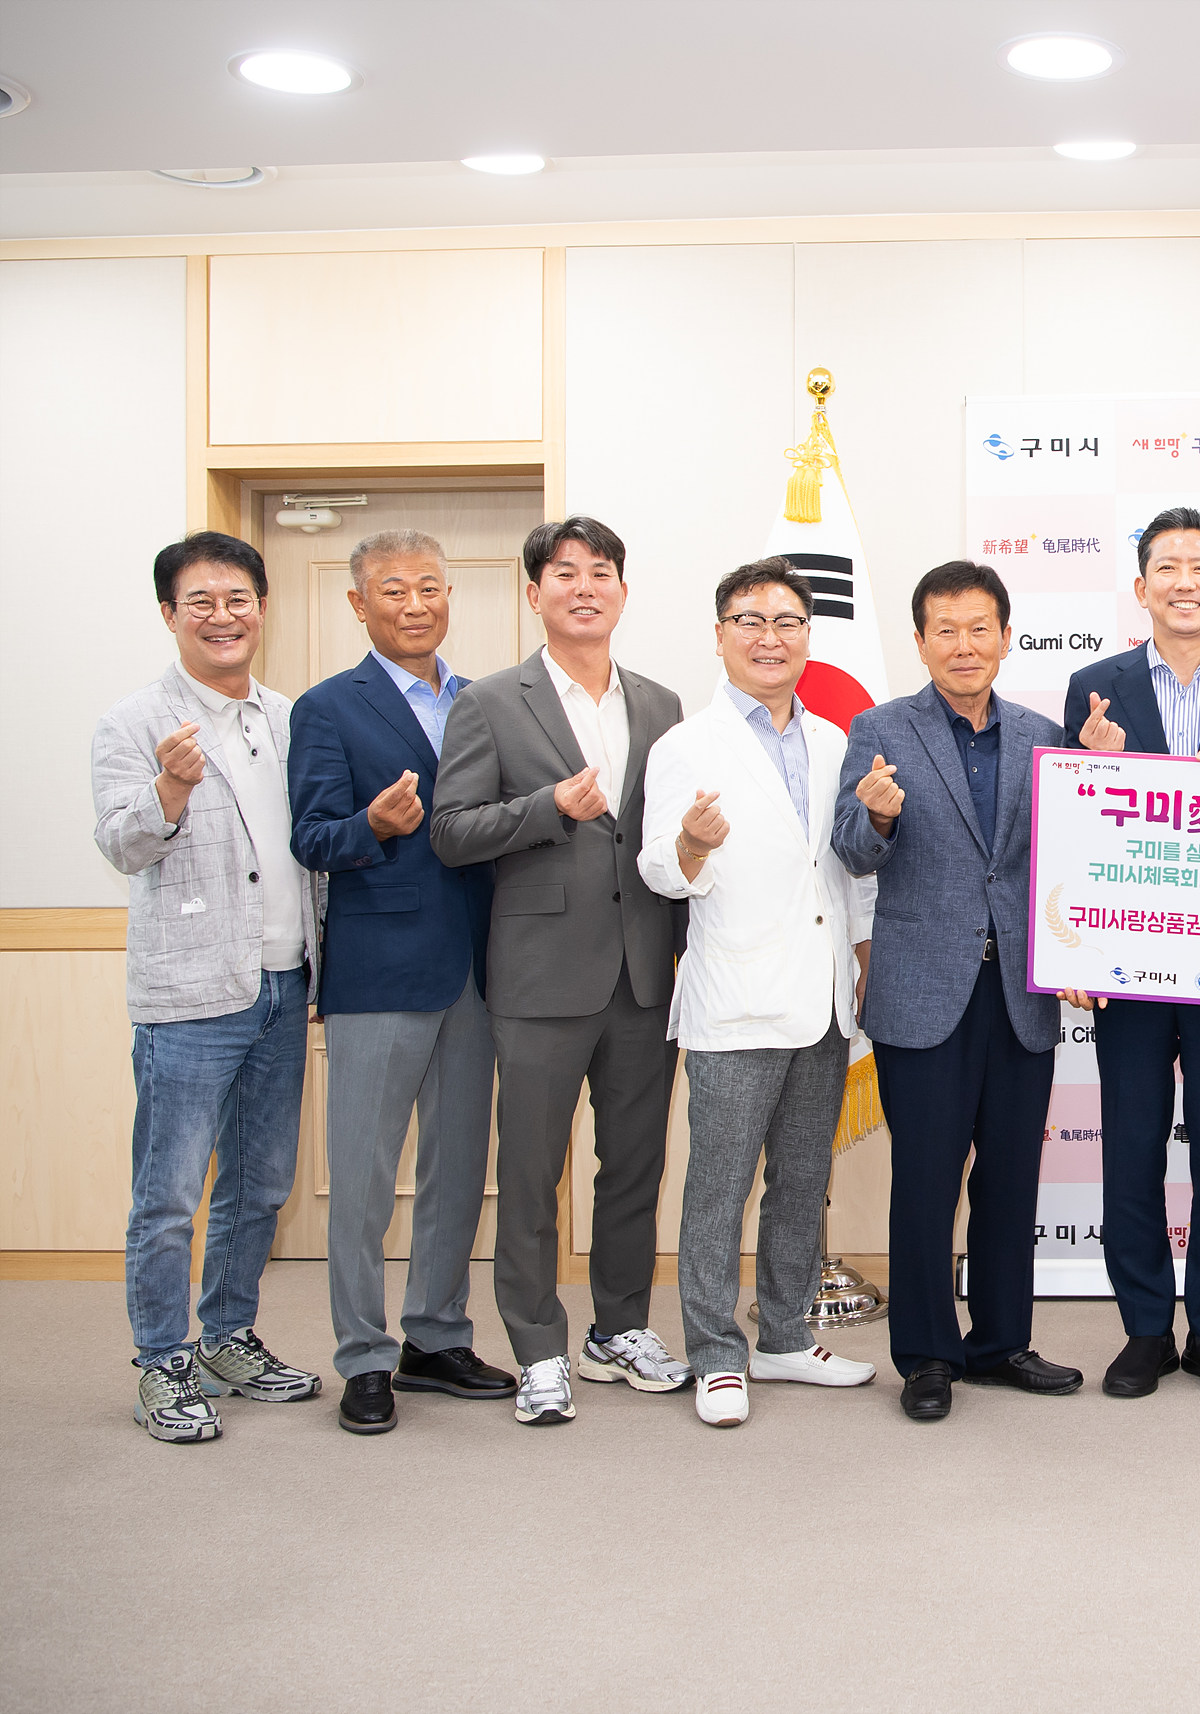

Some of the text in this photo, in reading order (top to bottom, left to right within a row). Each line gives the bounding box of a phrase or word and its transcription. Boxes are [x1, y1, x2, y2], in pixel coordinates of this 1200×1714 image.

[1020, 437, 1099, 458] 구미시
[1132, 438, 1149, 450] 새
[1154, 438, 1181, 458] 희망
[982, 538, 1029, 555] 新希望
[1019, 633, 1103, 652] Gumi City
[1052, 761, 1063, 769] 새
[1065, 762, 1081, 775] 희망
[1126, 839, 1181, 862] 구미를
[1133, 970, 1177, 985] 구미시
[1072, 1026, 1097, 1043] Cit
